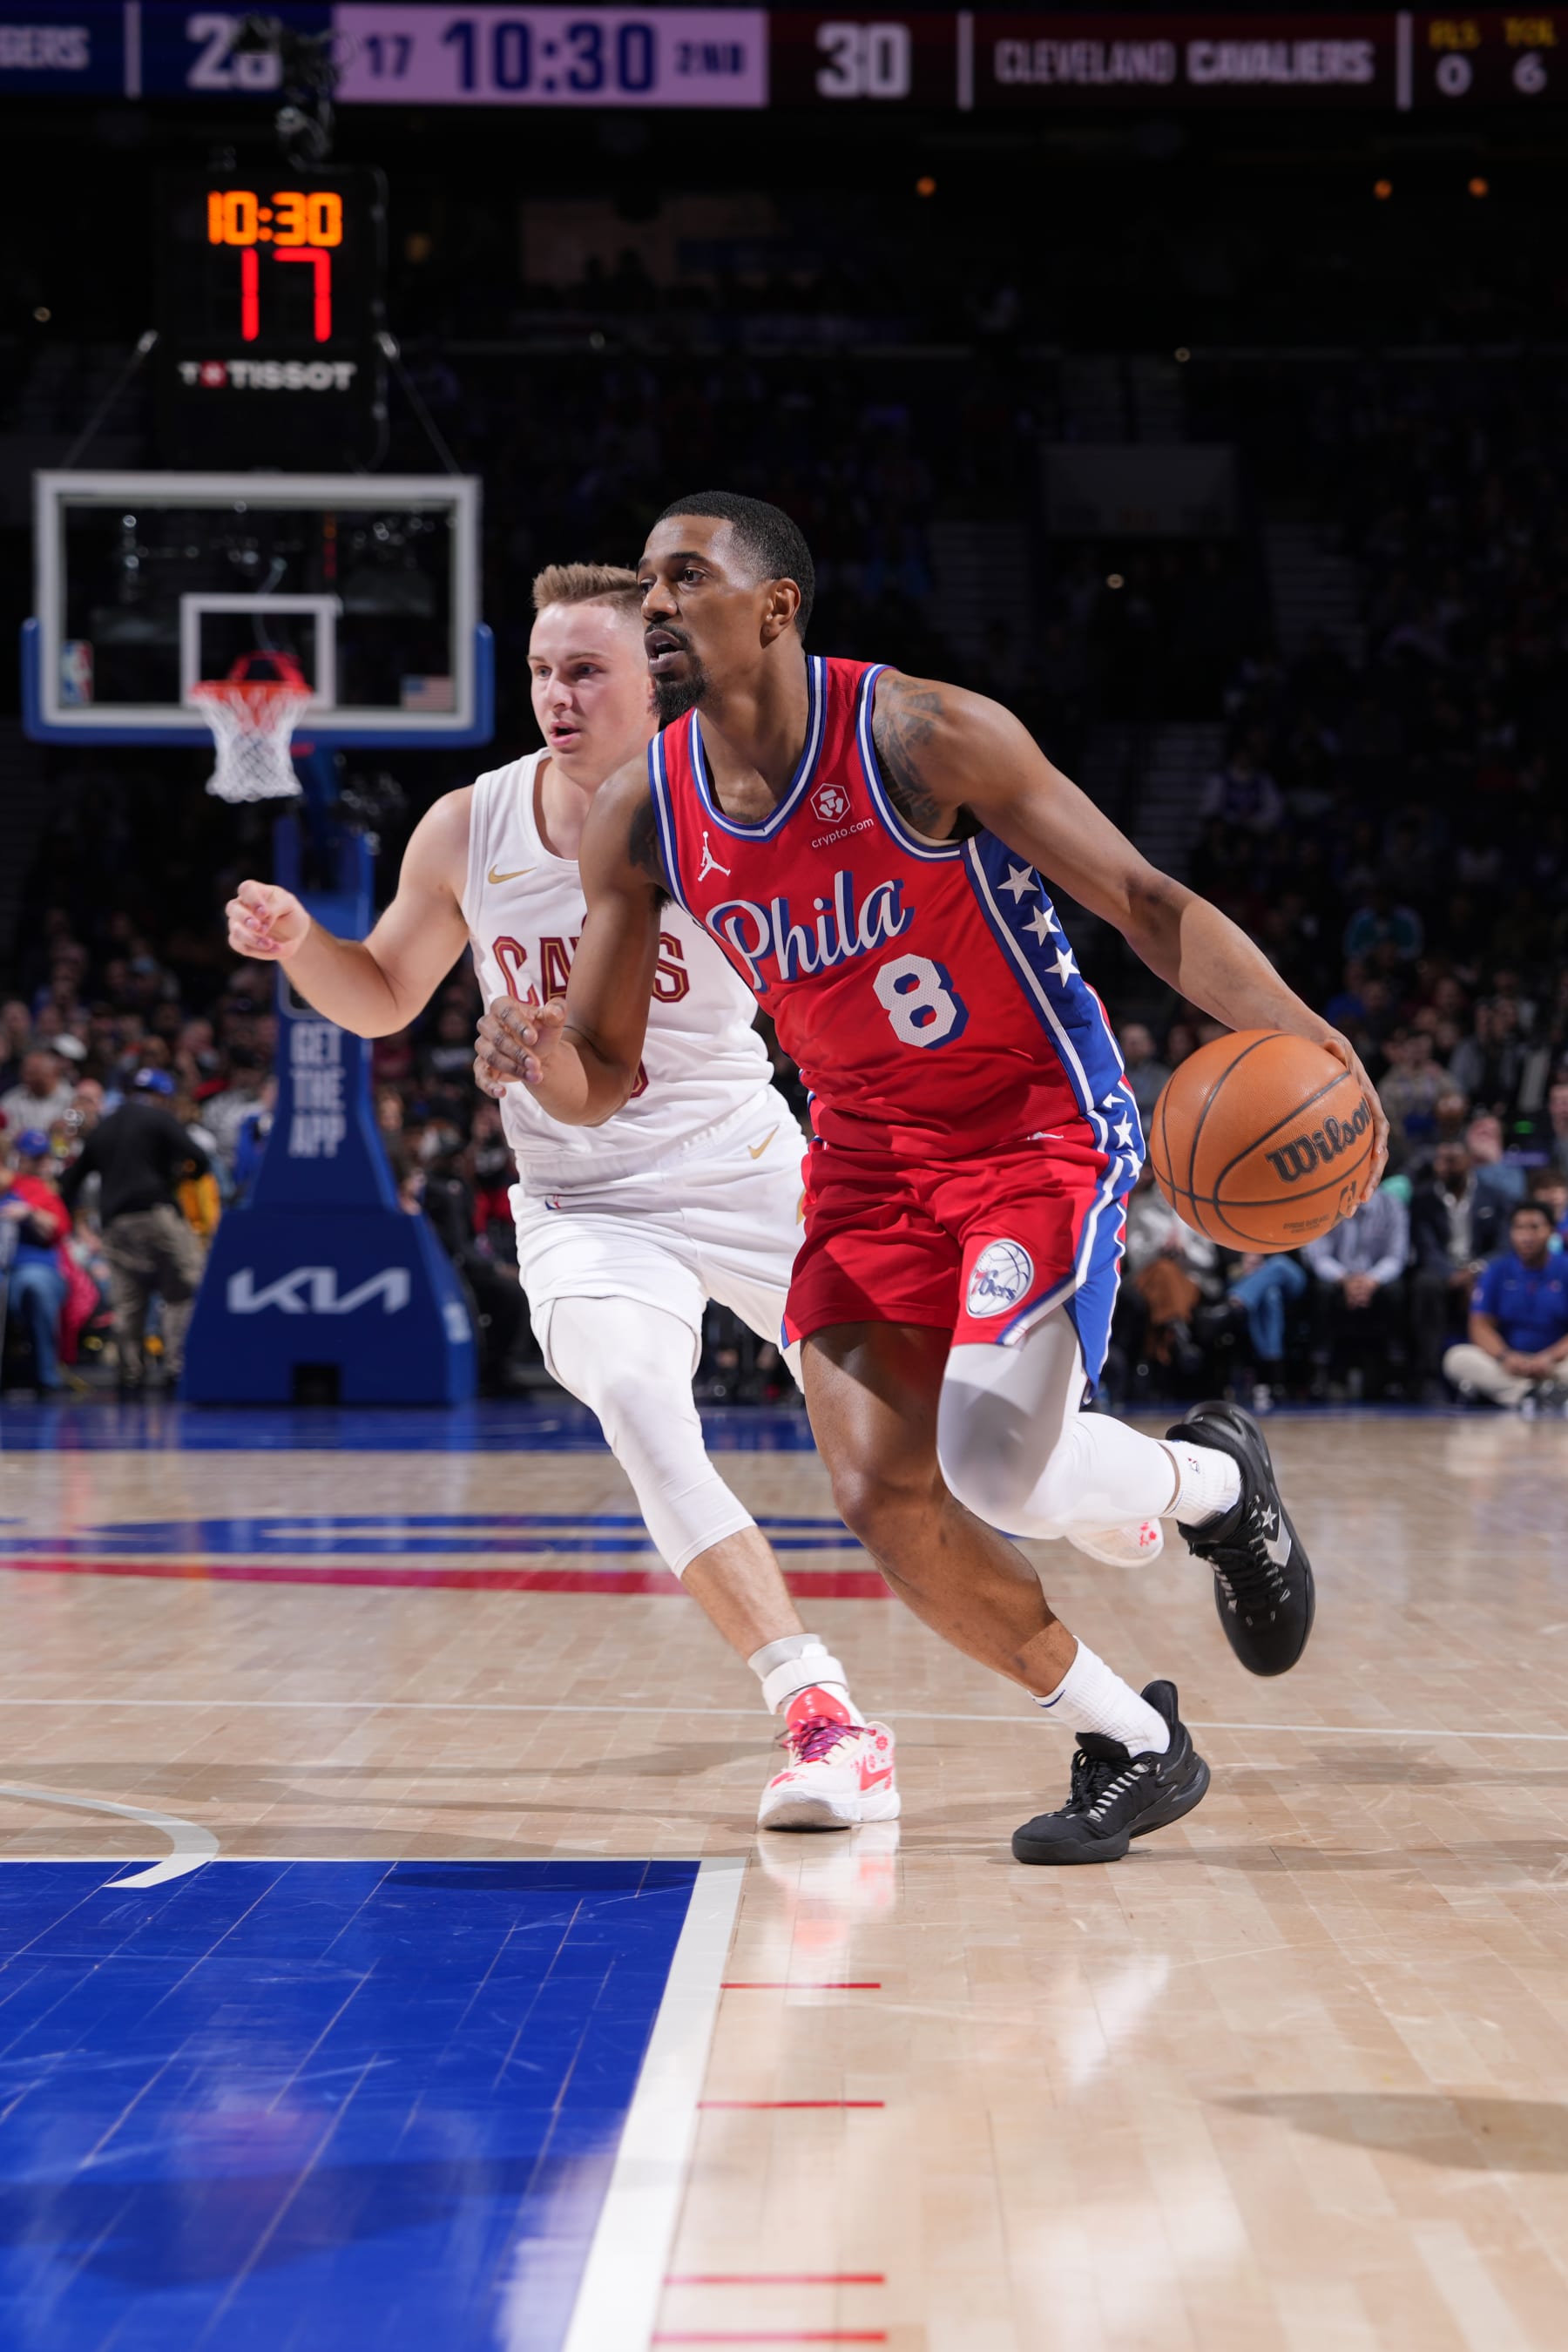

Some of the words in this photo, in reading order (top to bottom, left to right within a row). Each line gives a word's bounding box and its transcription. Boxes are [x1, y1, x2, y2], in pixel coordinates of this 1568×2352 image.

[364, 33, 414, 78] 17
[443, 20, 657, 93] 10:30
[676, 42, 746, 76] 2ND
[815, 21, 911, 98] 30
[994, 39, 1175, 84] CLEVELAND
[1186, 39, 1375, 84] CAVALIERS
[1436, 52, 1474, 97] 0
[1512, 51, 1549, 95] 6
[207, 190, 343, 247] 10:30
[241, 247, 332, 343] 17
[227, 360, 357, 390] TISSOT
[811, 818, 875, 848] crypto.com
[706, 870, 915, 993] Phila
[491, 931, 690, 1007] CAS
[873, 953, 970, 1051] 8
[290, 1022, 342, 1064] GET
[290, 1067, 346, 1110] THE
[288, 1114, 347, 1159] APP
[1265, 1097, 1371, 1185] Wilson
[226, 1266, 410, 1315] KIA
